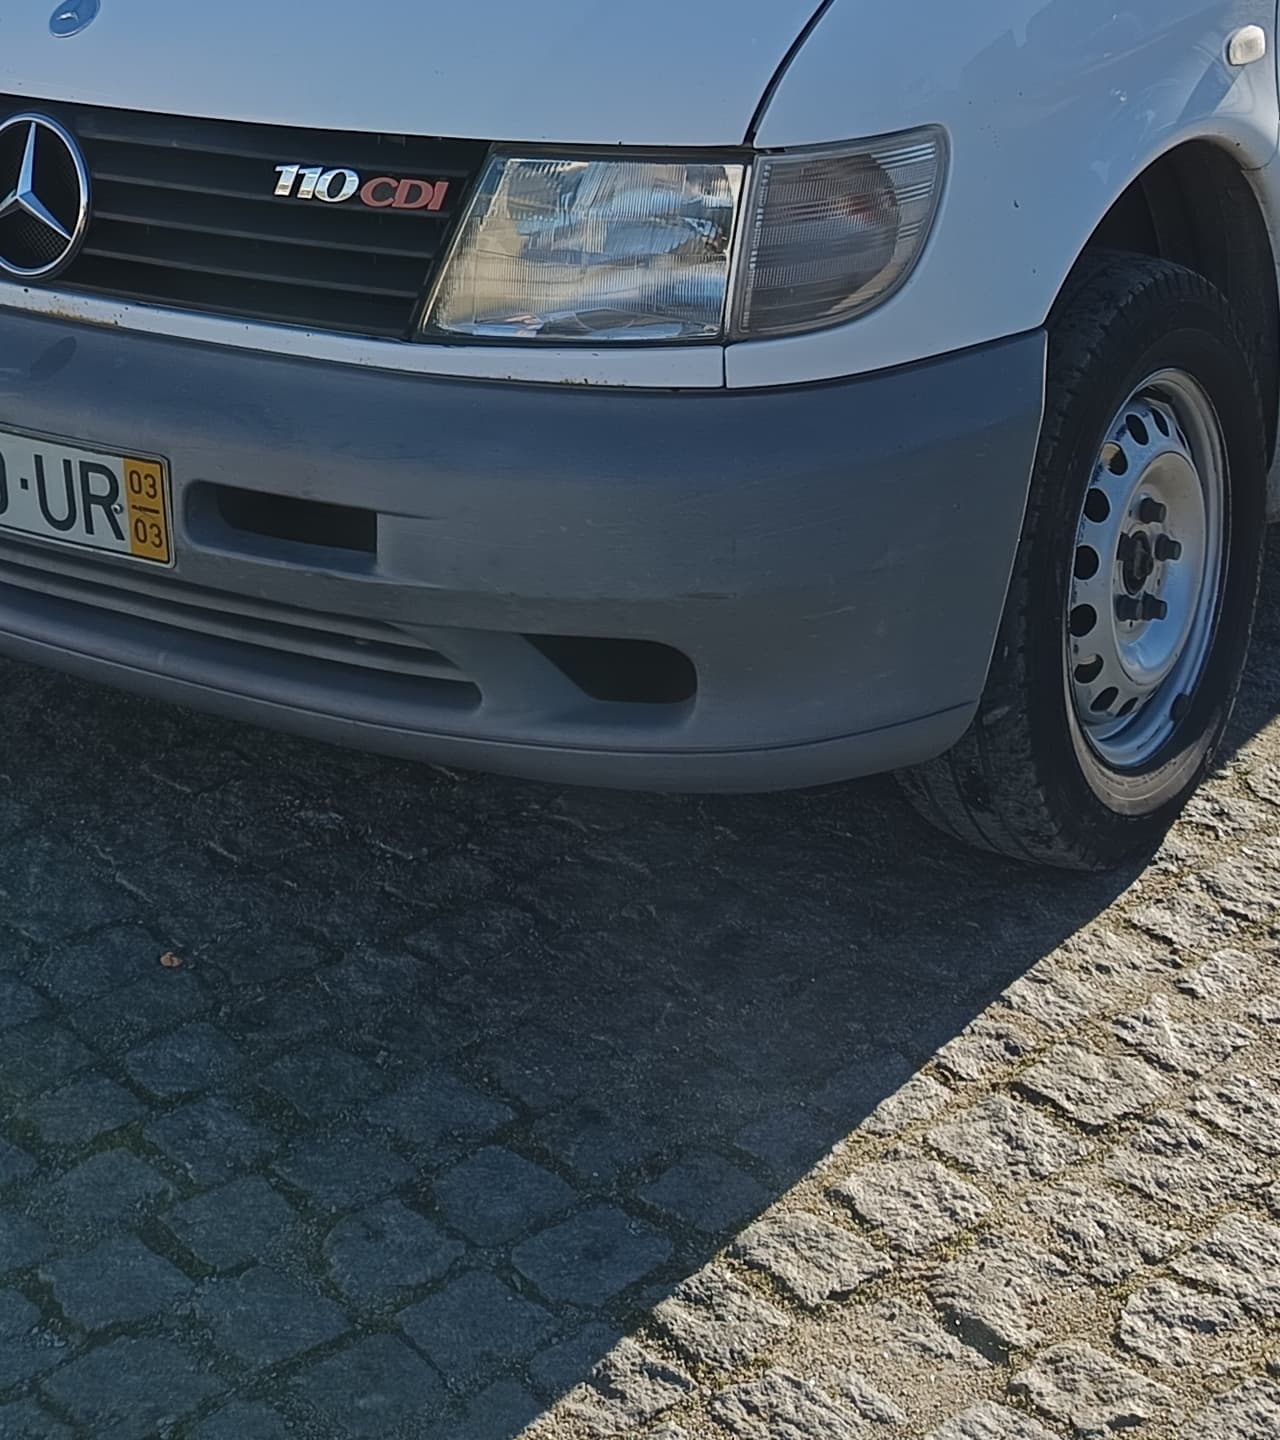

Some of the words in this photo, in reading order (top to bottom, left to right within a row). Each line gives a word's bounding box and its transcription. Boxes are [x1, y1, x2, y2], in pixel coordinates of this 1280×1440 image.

[274, 164, 360, 203] 110
[360, 176, 450, 211] CDI
[129, 470, 157, 499] 03
[134, 518, 163, 548] 03
